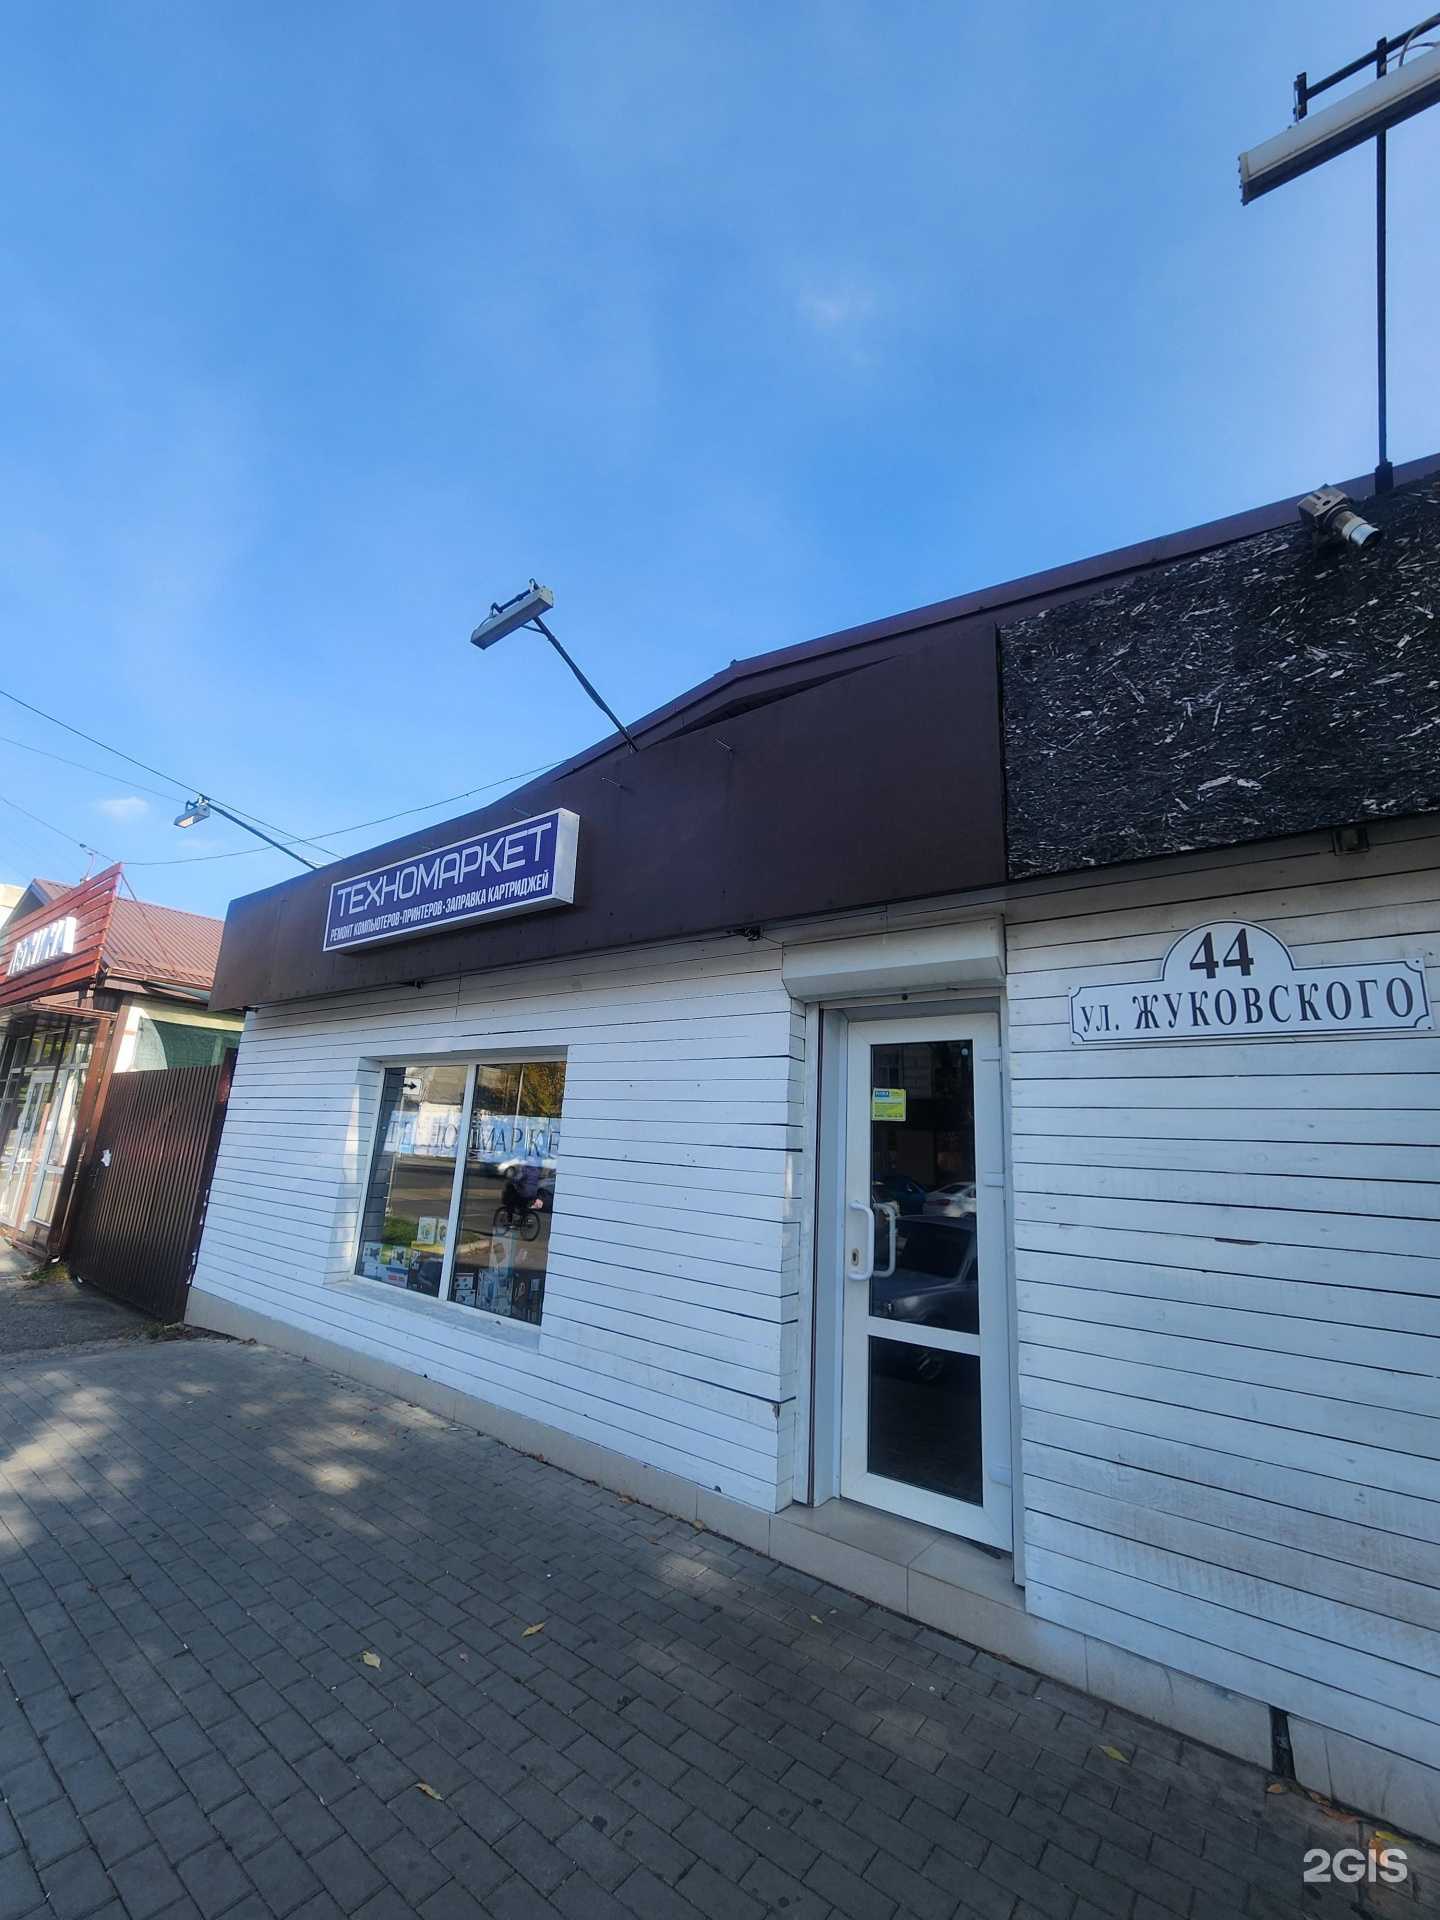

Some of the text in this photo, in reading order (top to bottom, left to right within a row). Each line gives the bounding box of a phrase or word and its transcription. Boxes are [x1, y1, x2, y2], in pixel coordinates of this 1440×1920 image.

[337, 821, 552, 917] ТЕХНОМАРКЕТ
[330, 924, 353, 942] РЕМОНТ
[445, 888, 486, 913] ЗАПРАВКА
[487, 870, 549, 903] КАРТРИДЖЕЙ
[1189, 927, 1254, 980] 44
[1132, 976, 1415, 1030] ЖУКОВСКОГО
